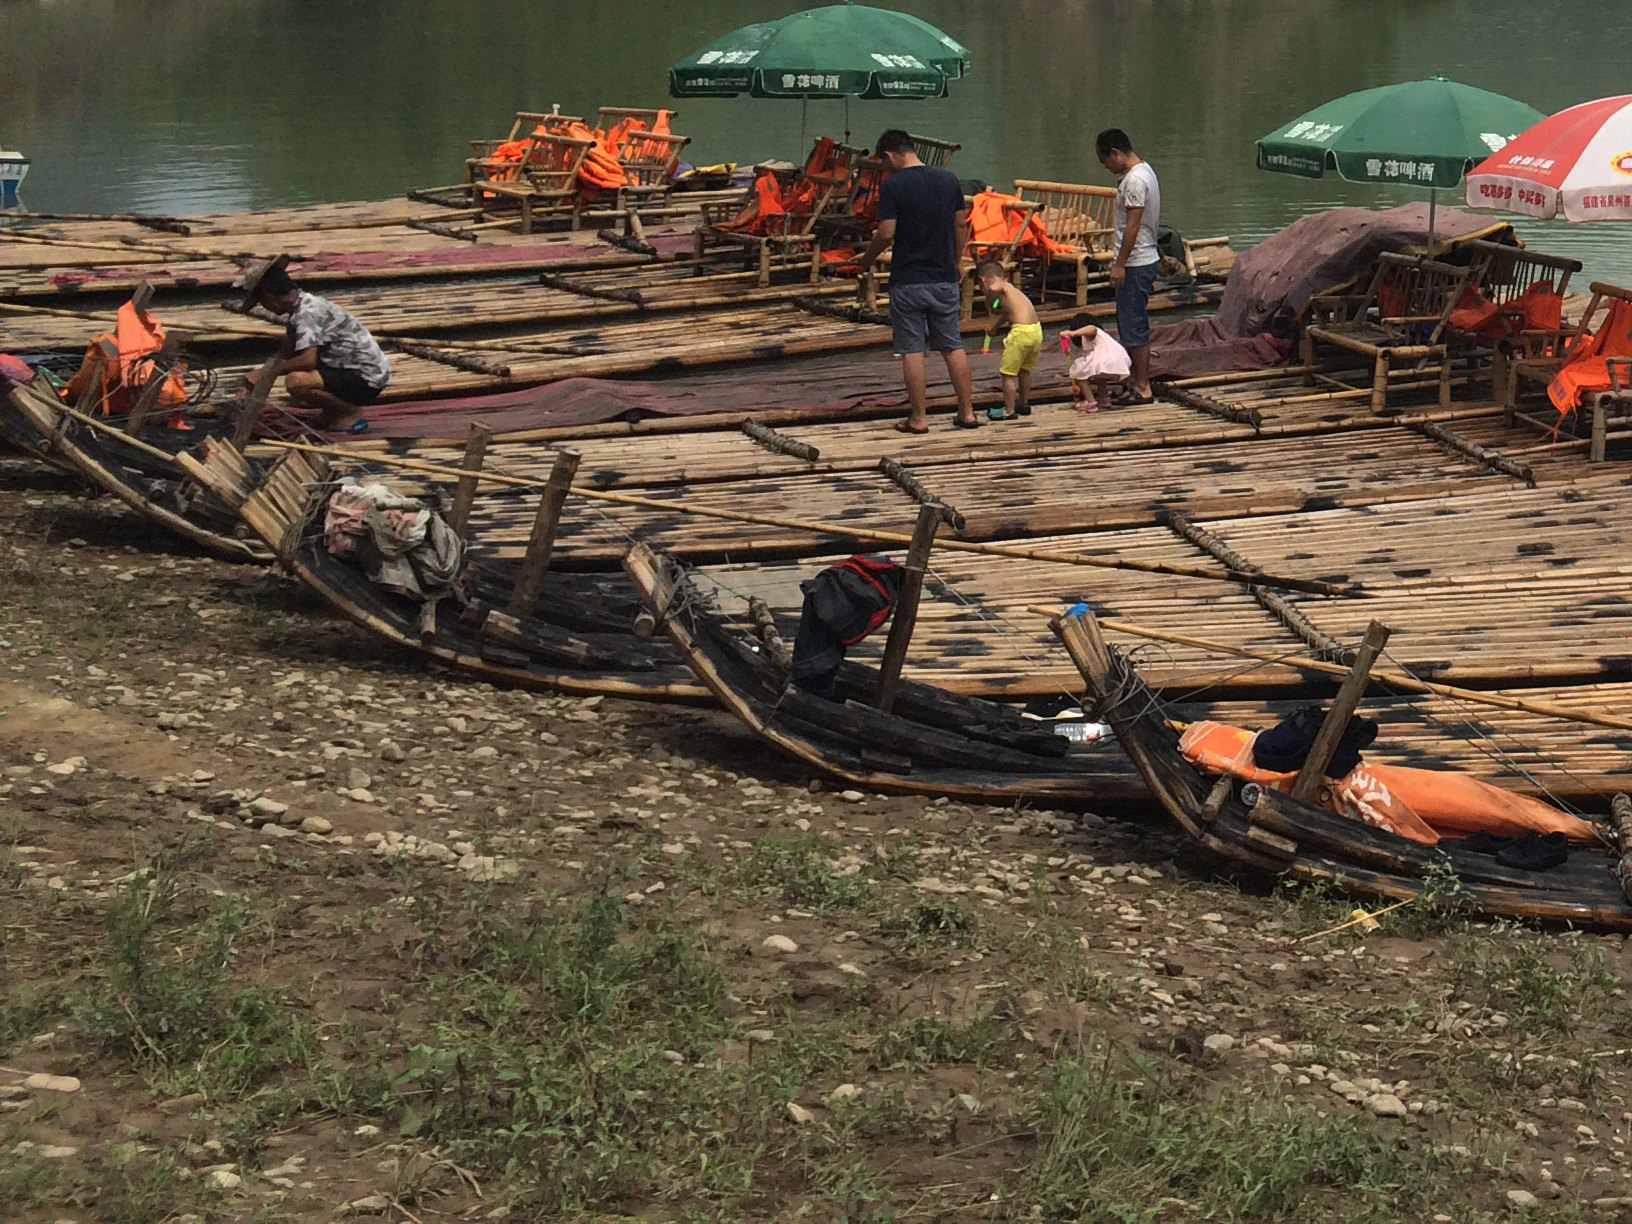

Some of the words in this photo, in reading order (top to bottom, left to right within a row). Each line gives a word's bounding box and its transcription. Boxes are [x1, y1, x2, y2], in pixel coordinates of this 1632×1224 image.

[781, 73, 840, 89] 雪花啤酒
[1366, 158, 1435, 182] 雪花啤酒
